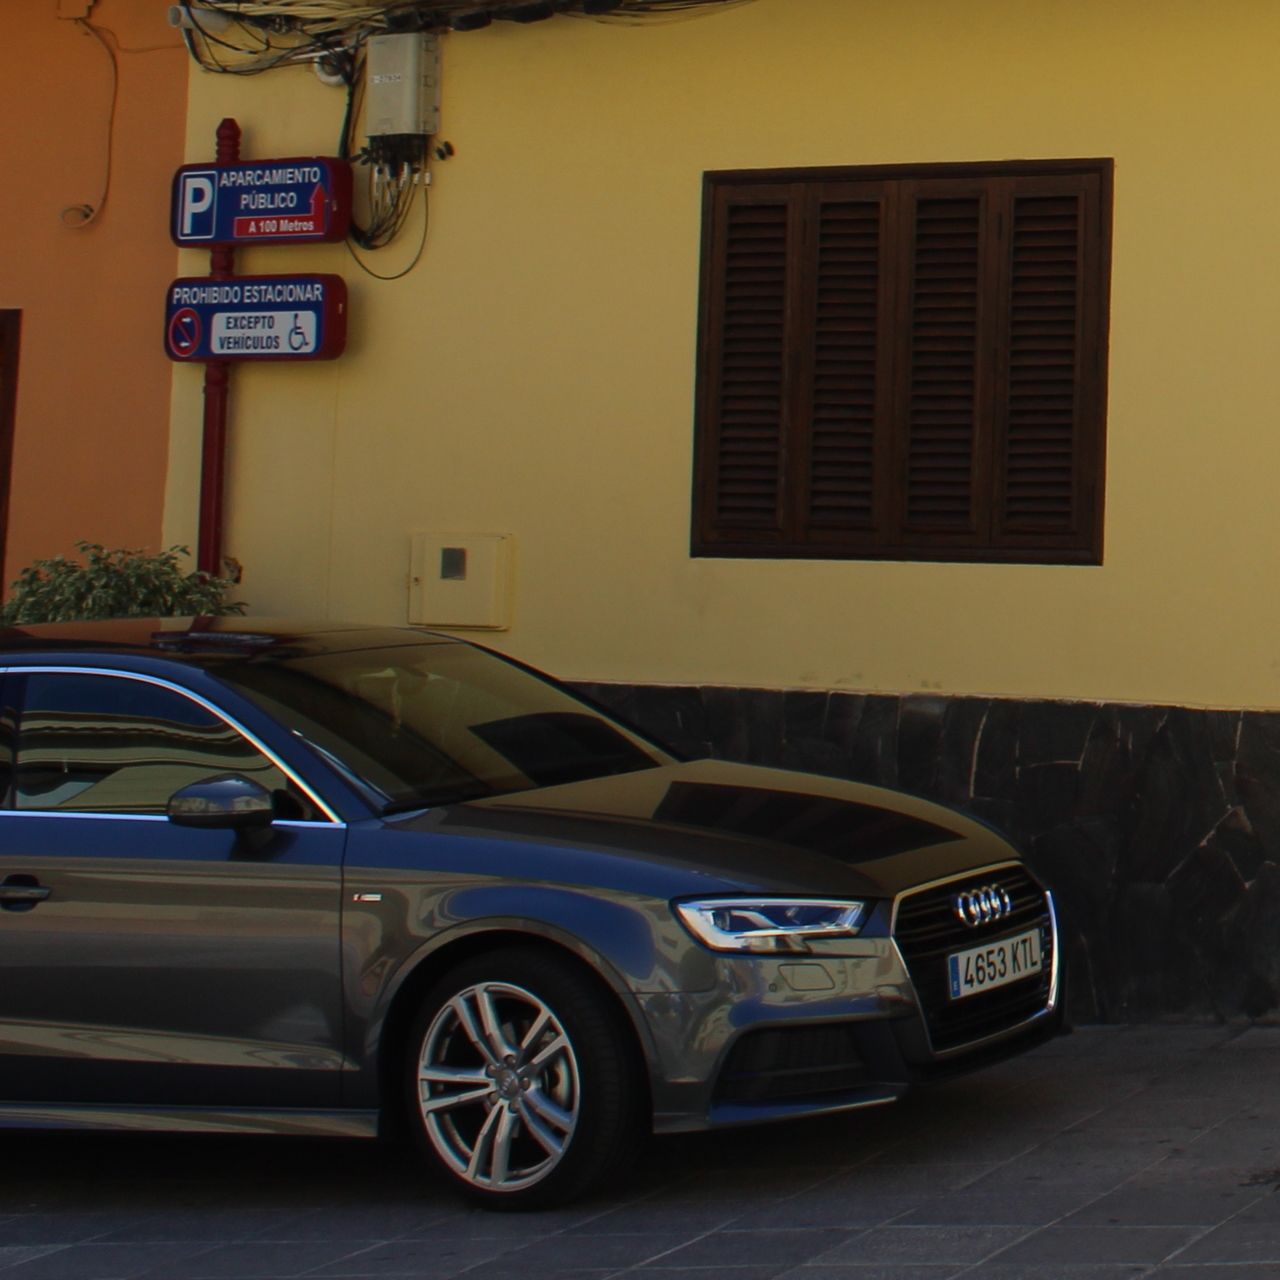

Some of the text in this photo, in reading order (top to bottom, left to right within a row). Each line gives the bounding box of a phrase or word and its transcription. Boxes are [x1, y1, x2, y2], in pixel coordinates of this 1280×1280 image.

[219, 167, 321, 187] APARCAMIENTO
[183, 177, 213, 234] P
[240, 190, 297, 210] PÚBLICO
[248, 219, 314, 233] A 100 Metros
[172, 284, 323, 304] PROHIBIDO ESTACIONAR
[225, 315, 275, 330] EXCEPTO
[219, 332, 280, 350] VEHÍCULOS
[963, 936, 1038, 988] 4653 KTL
